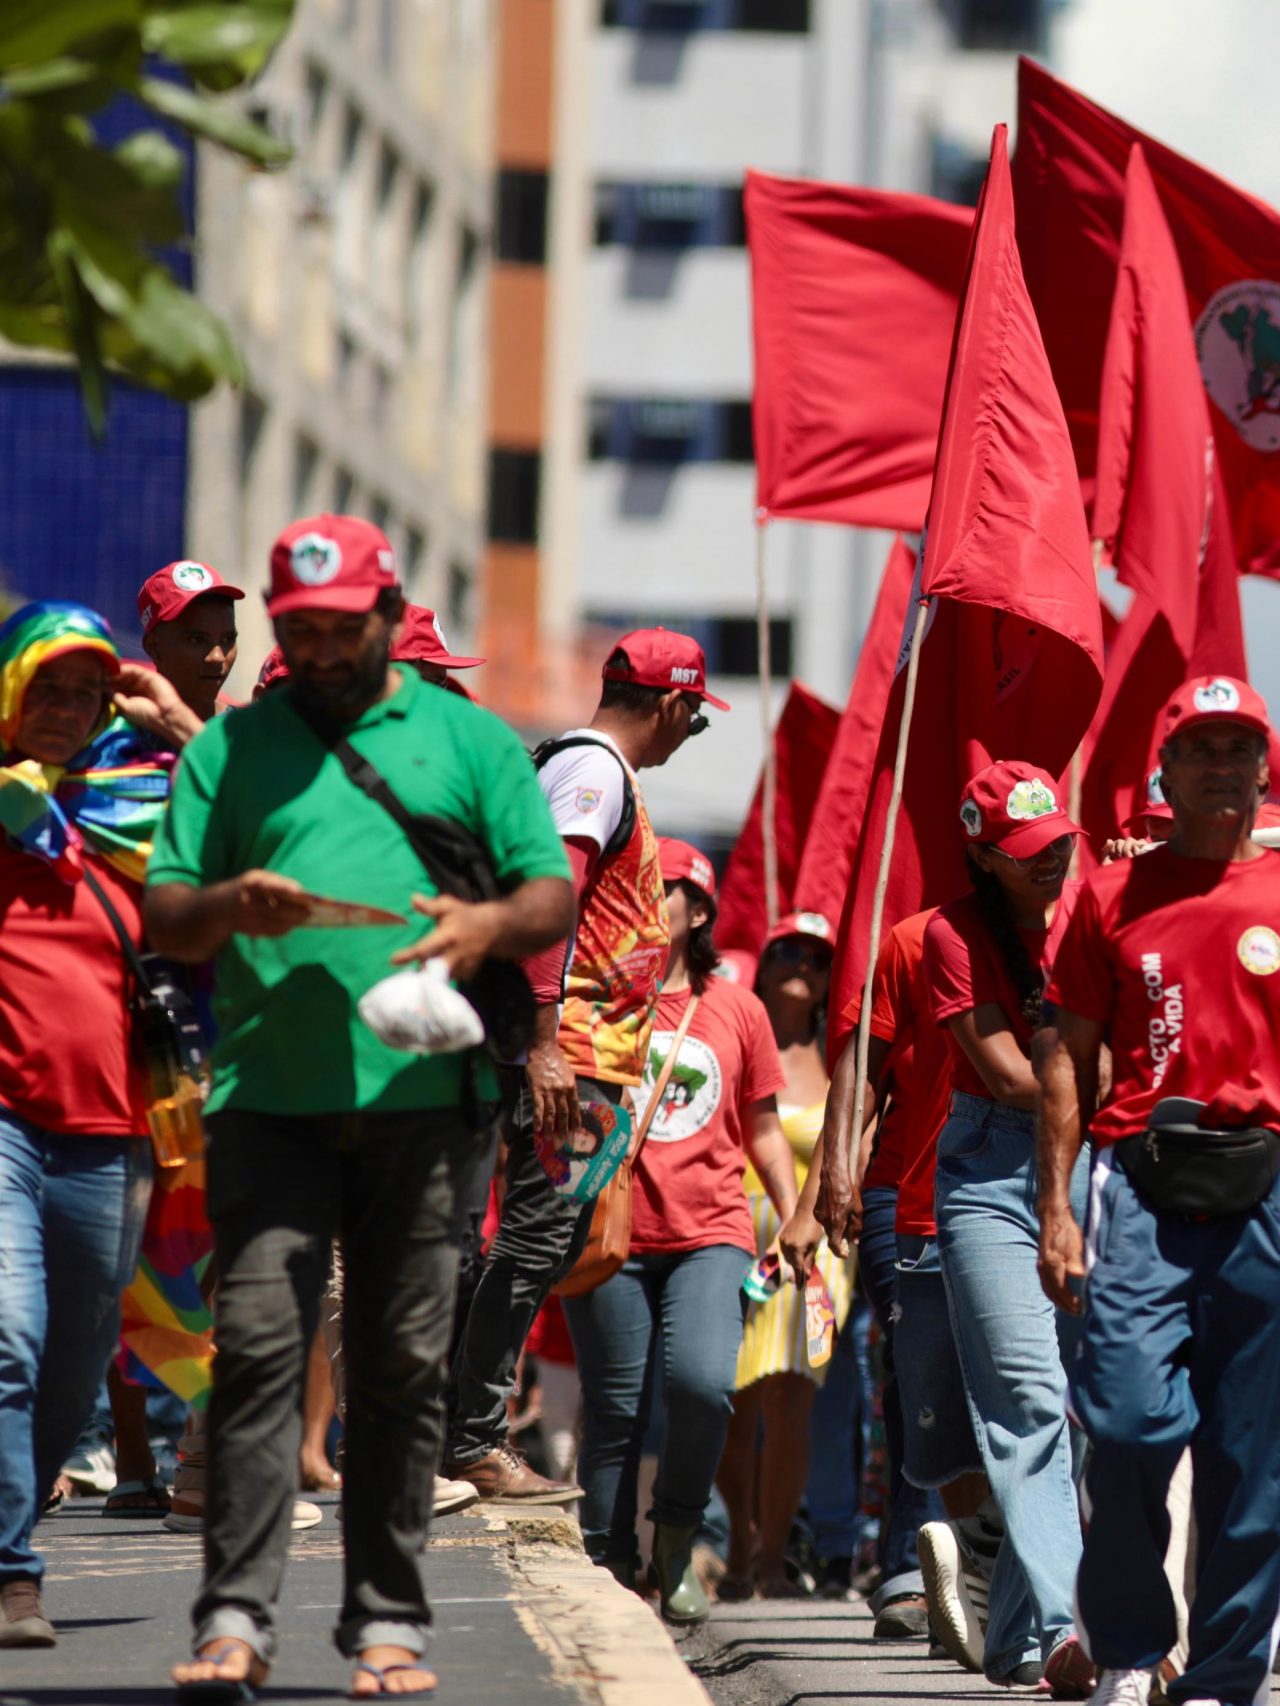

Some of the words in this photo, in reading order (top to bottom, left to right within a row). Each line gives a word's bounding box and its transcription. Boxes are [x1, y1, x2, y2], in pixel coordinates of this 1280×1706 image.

[670, 667, 699, 684] MST
[1141, 953, 1163, 1002] COM
[1164, 983, 1184, 1035] VIDA
[1168, 1037, 1181, 1054] A
